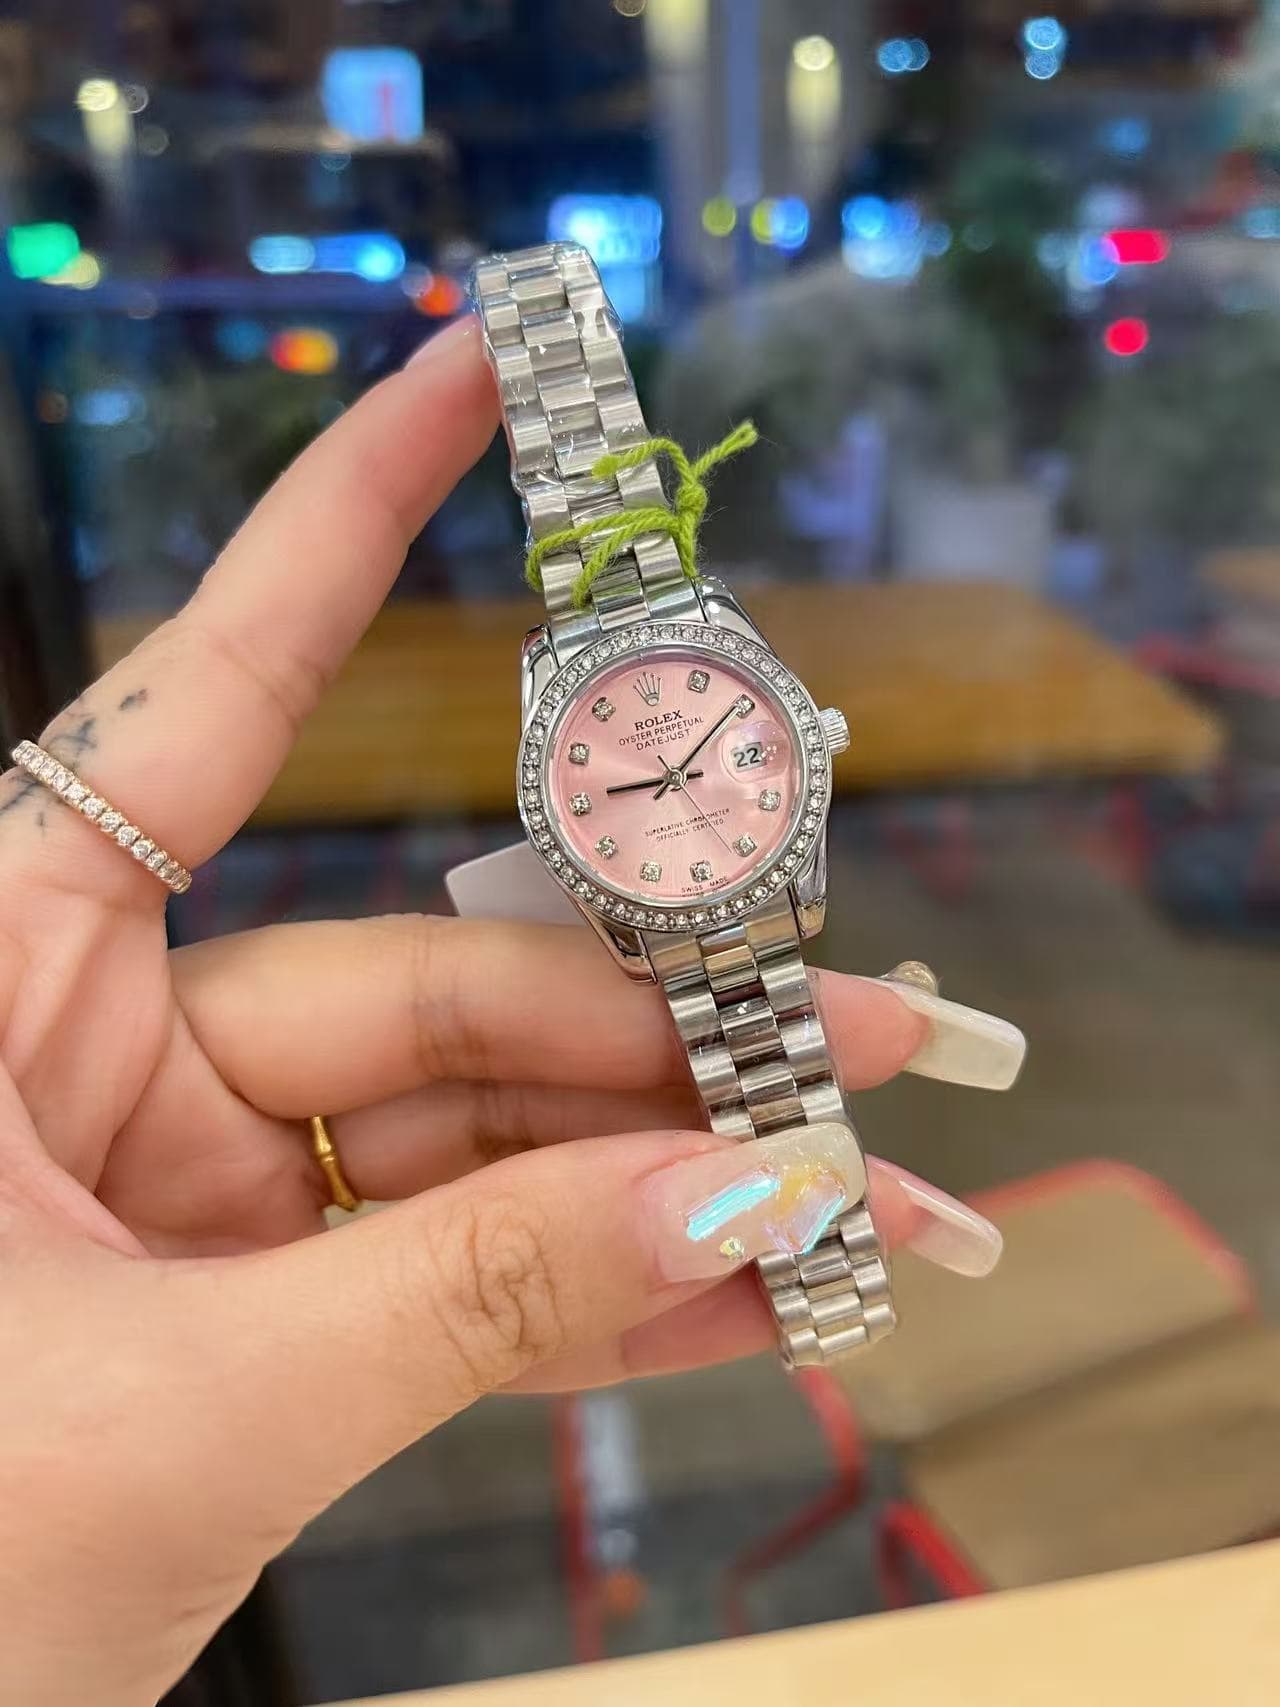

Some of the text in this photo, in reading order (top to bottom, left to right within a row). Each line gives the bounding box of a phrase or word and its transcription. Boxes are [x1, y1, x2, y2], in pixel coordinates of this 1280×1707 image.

[634, 709, 683, 731] ROLEX
[619, 716, 705, 746] OYSTER PERPETUAL
[636, 729, 690, 751] DATEJUST
[733, 747, 760, 768] 22
[645, 821, 684, 837] SUPERLATIVE
[656, 828, 689, 841] OFFICIALLY
[681, 884, 704, 893] SWISS
